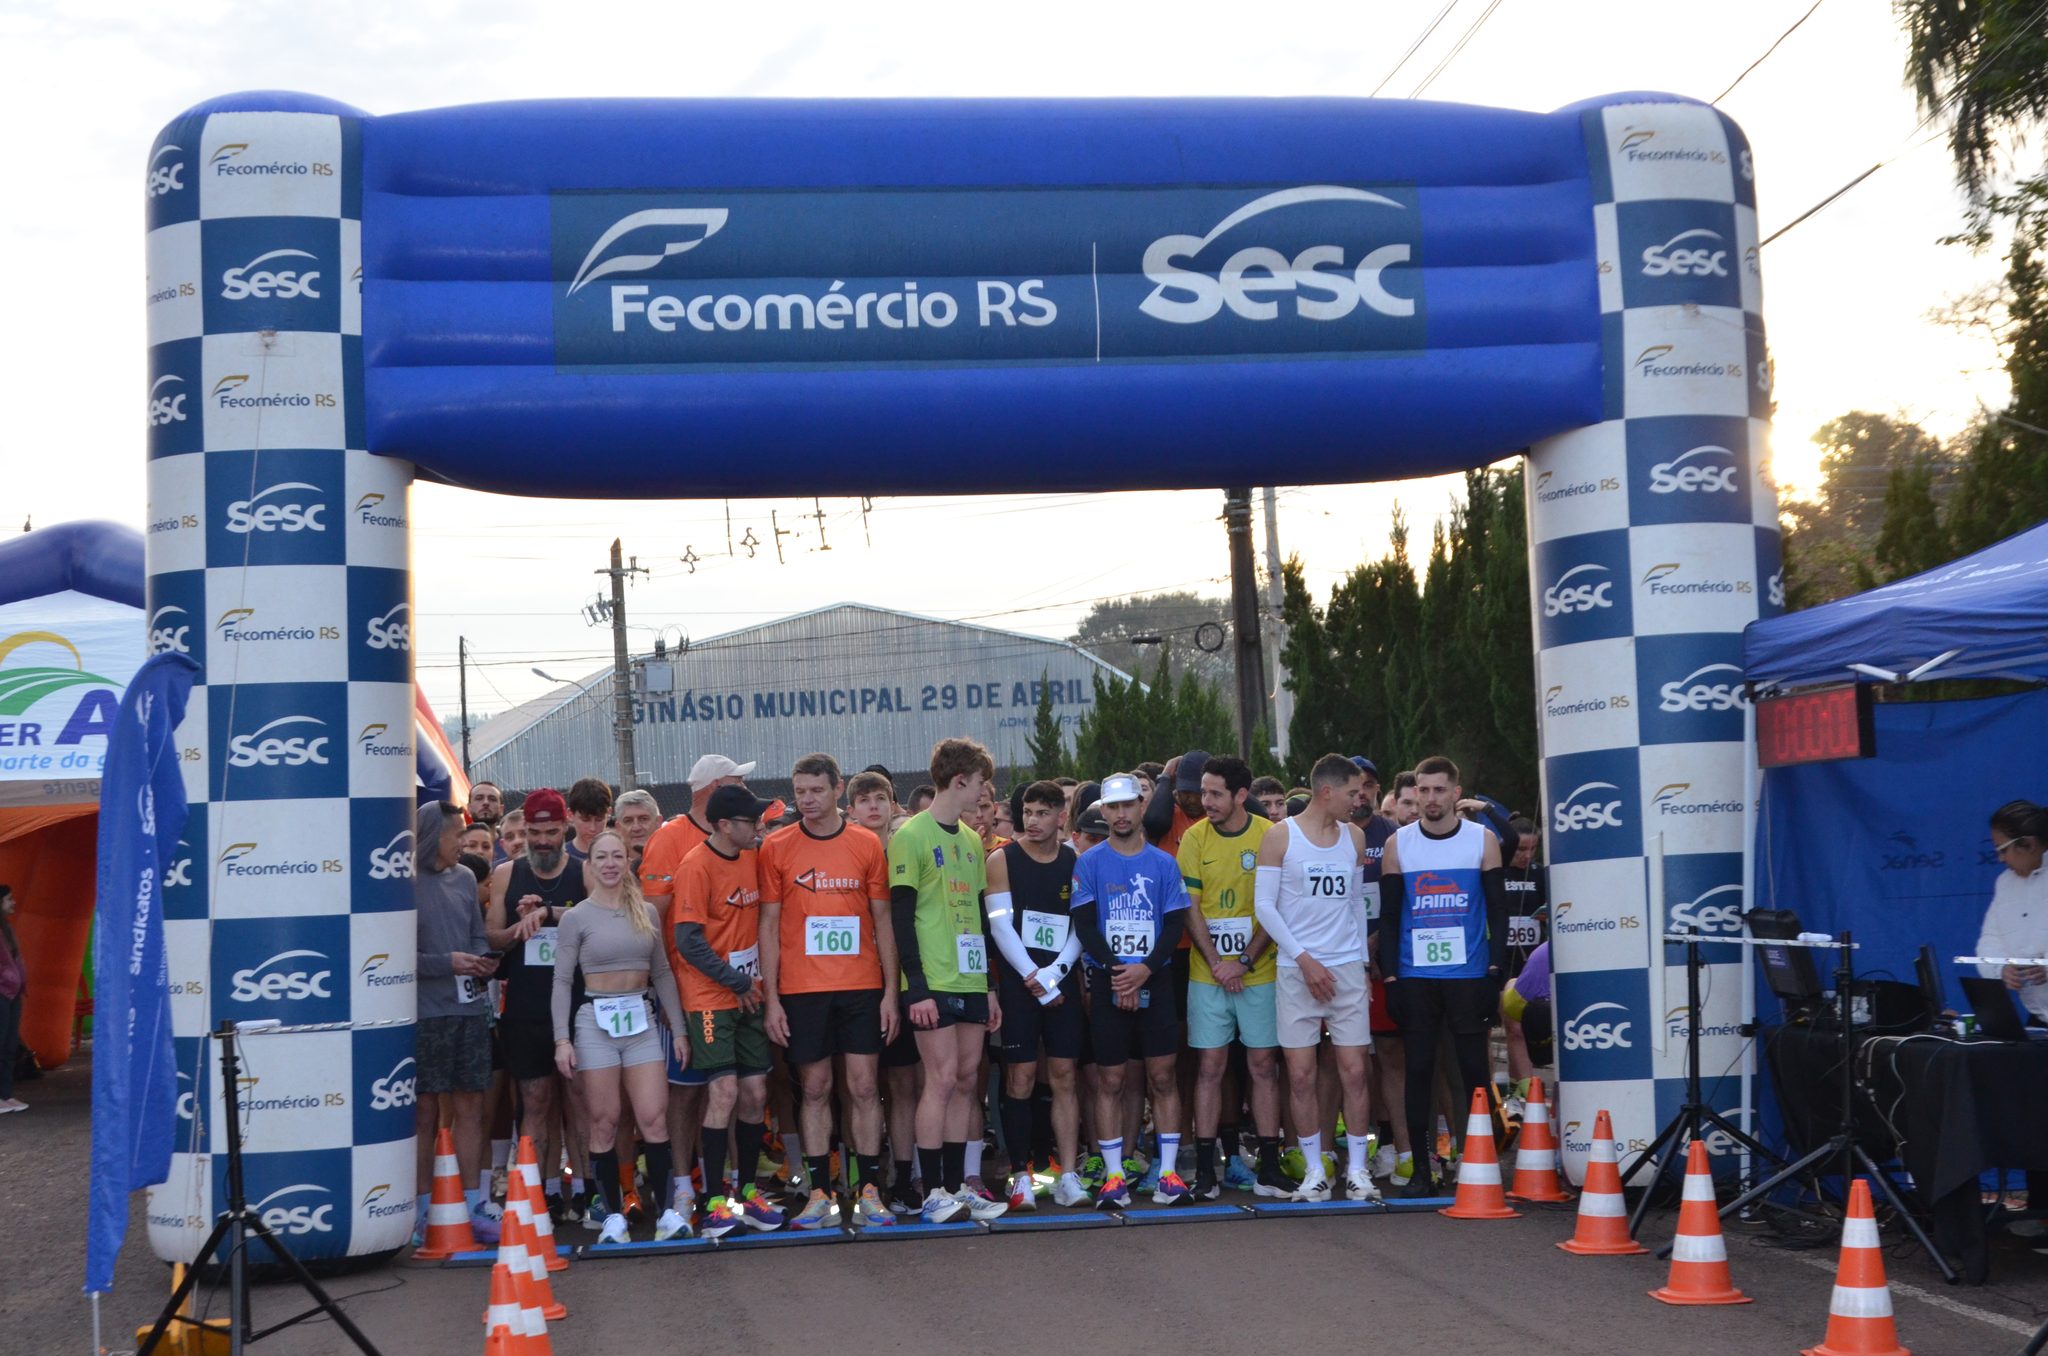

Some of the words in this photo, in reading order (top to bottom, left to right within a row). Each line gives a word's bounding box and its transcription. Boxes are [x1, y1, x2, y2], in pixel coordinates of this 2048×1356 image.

[1628, 147, 1708, 162] Fecomércio
[1710, 152, 1726, 164] RS
[217, 161, 307, 177] Fecomércio
[312, 163, 333, 177] RS
[1641, 245, 1728, 278] Sesc
[179, 282, 195, 297] RS
[221, 267, 320, 300] Sesc
[1138, 234, 1415, 324] Sesc
[611, 280, 958, 332] Fecomércio
[978, 279, 1057, 327] RS
[1643, 362, 1725, 378] Fecomércio
[1726, 363, 1743, 378] RS
[220, 392, 310, 409] Fecomércio
[315, 393, 336, 408] RS
[1649, 462, 1738, 494] Sesc
[1537, 482, 1597, 504] Fecomércio
[1600, 478, 1620, 491] RS
[182, 515, 198, 528] RS
[225, 500, 326, 533] Sesc
[1650, 579, 1733, 595] Fecomércio
[1737, 581, 1752, 593] RS
[1544, 581, 1613, 617] Sesc
[224, 627, 315, 642] Fecomércio
[319, 626, 340, 640] RS
[631, 689, 744, 725] GINÁSIO
[754, 686, 911, 719] MUNICIPAL
[922, 685, 958, 711] 29
[966, 683, 1002, 709] DE
[1012, 679, 1091, 706] ABRIL
[1547, 698, 1606, 718] Fecomércio
[1611, 695, 1630, 709] RS
[1659, 681, 1746, 713] Sesc
[60, 751, 89, 769] da
[184, 748, 201, 761] RS
[228, 735, 329, 767] Sesc
[1554, 800, 1623, 833] Sesc
[1661, 800, 1744, 815] Fecomércio
[227, 860, 318, 877] Fecomércio
[322, 859, 343, 874] RS
[1309, 875, 1346, 896] 703
[1219, 887, 1236, 909] 10
[1412, 893, 1469, 910] JAIME
[130, 868, 154, 976] sindicatos
[1557, 917, 1616, 933] Fecomércio
[1619, 916, 1640, 930] RS
[813, 930, 853, 952] 160
[1034, 925, 1055, 948] 46
[1111, 934, 1149, 955] 854
[1210, 932, 1246, 953] 708
[1508, 927, 1536, 943] 969
[967, 949, 982, 971] 62
[1426, 941, 1453, 963] 85
[186, 981, 203, 994] RS
[230, 969, 332, 1002] Sesc
[610, 1010, 633, 1033] 11
[1564, 1020, 1632, 1050] Sesc
[236, 1095, 320, 1111] ecomércio
[324, 1093, 345, 1107] RS
[1628, 1138, 1648, 1152] RS
